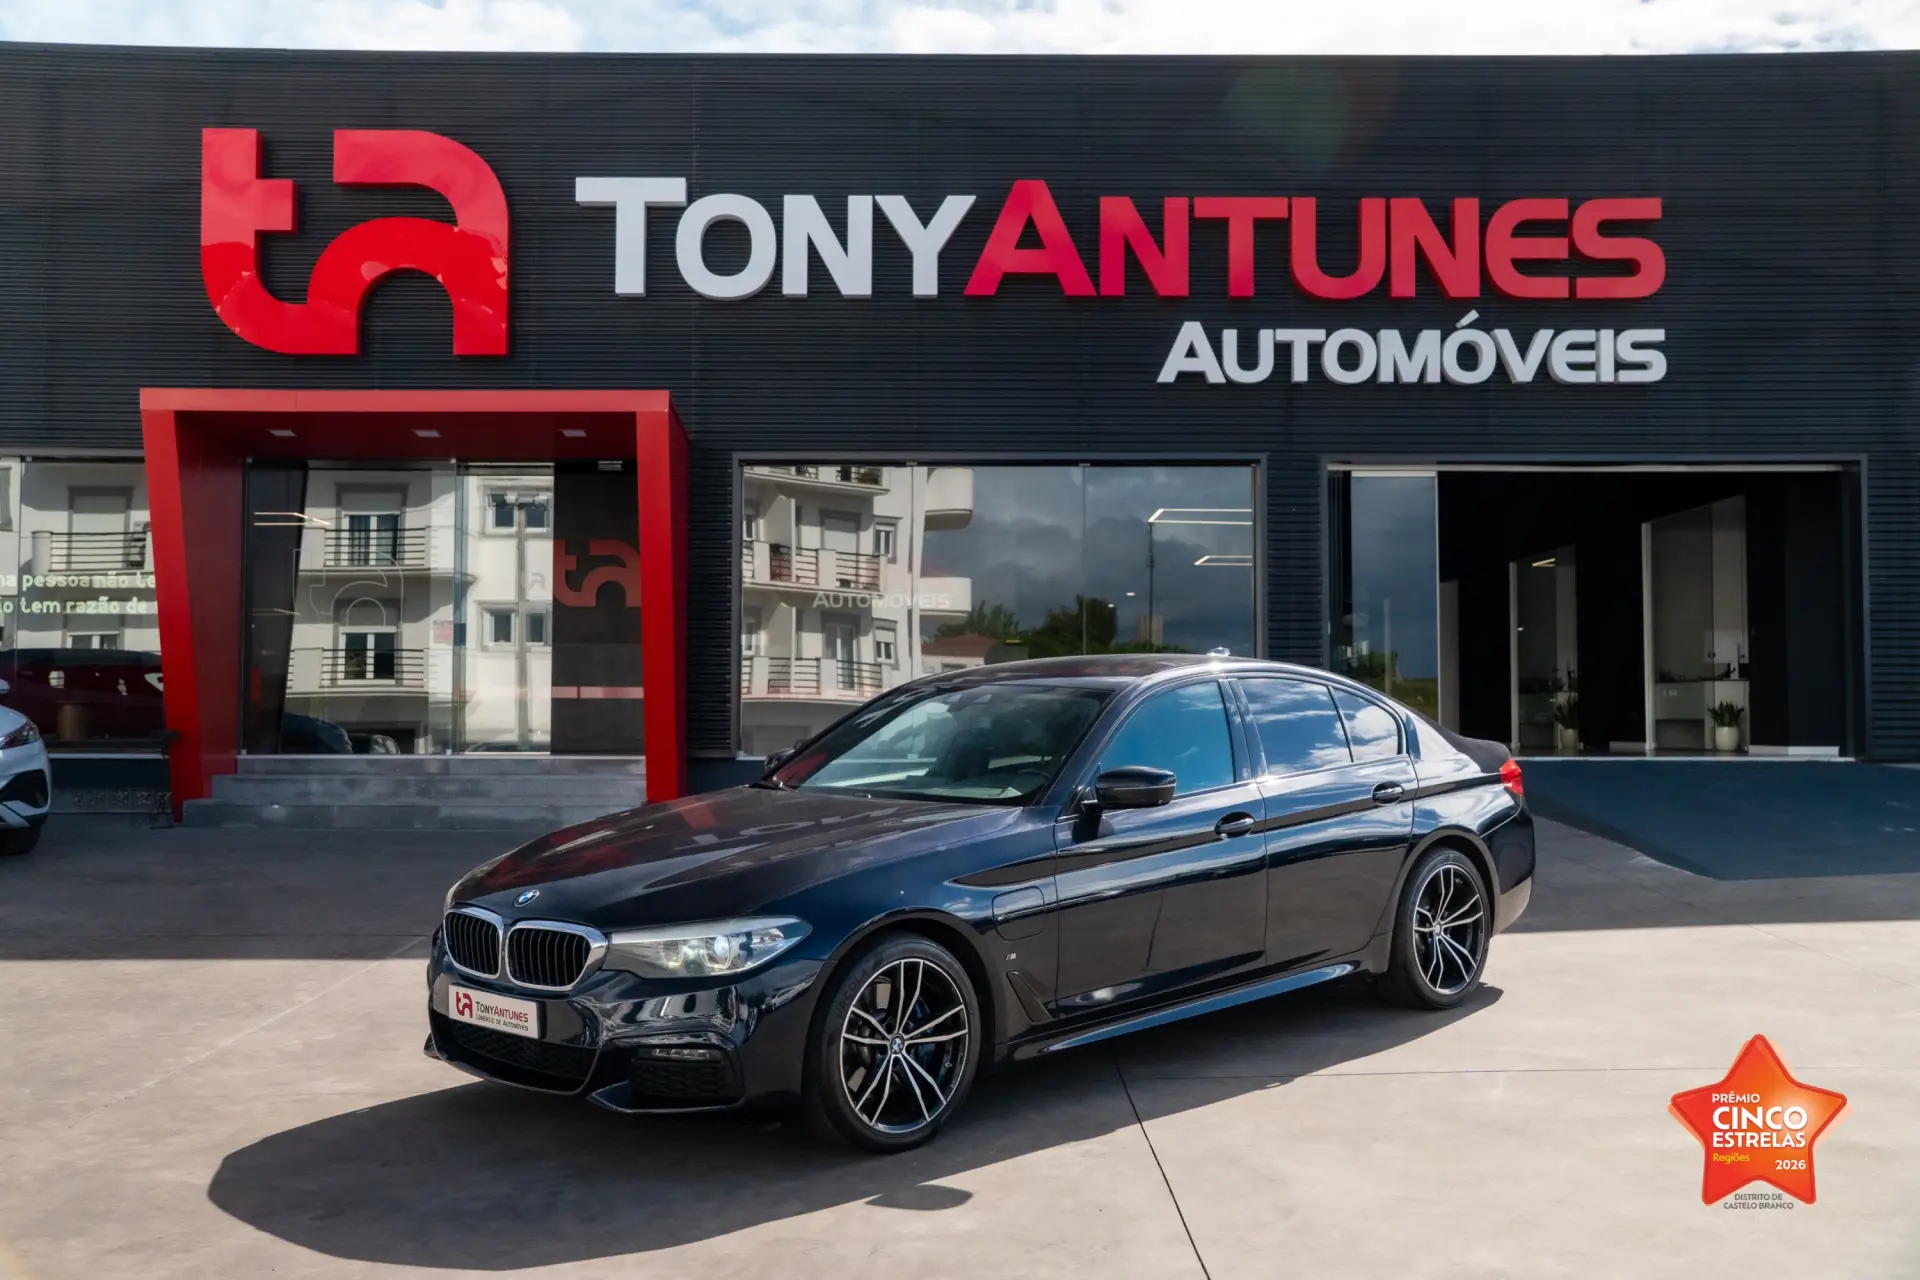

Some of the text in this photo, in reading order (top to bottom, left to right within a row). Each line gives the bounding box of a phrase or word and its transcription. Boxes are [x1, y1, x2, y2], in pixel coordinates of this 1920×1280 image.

[1156, 309, 1668, 384] AUTOMÓVEIS
[22, 573, 89, 591] pessoa
[92, 571, 128, 588] não
[20, 597, 61, 613] tem
[66, 596, 120, 613] razão
[126, 597, 148, 613] de
